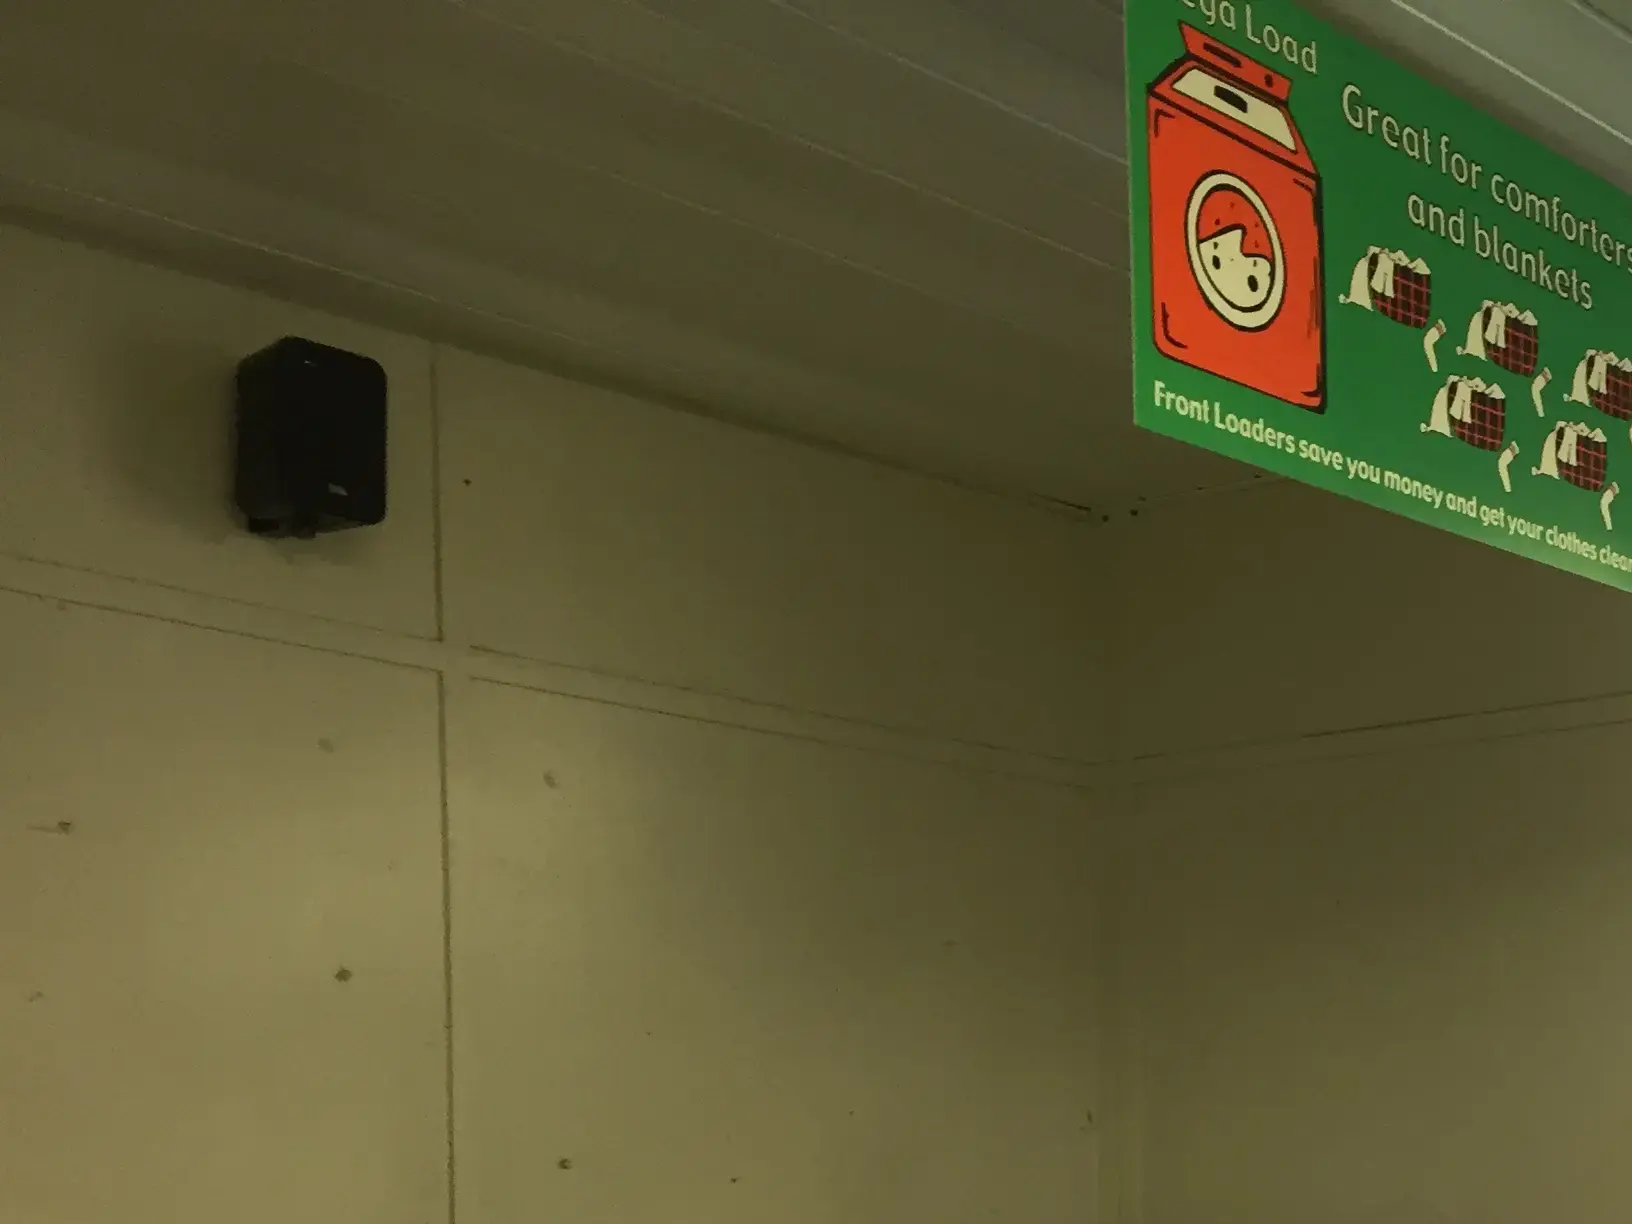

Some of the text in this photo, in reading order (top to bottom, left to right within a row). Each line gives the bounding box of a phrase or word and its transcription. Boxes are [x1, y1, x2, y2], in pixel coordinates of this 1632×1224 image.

[1245, 4, 1318, 75] Load
[1342, 84, 1432, 164] Great
[1440, 134, 1482, 189] for
[1407, 194, 1592, 310] and blankets
[1154, 379, 1209, 424] Front
[1213, 401, 1296, 454] Loaders
[1298, 437, 1344, 471] save
[1346, 455, 1380, 484] you
[1383, 471, 1442, 509] money
[1445, 492, 1477, 518] and
[1479, 504, 1504, 527] get
[1506, 513, 1544, 540] your
[1545, 525, 1597, 561] clothes
